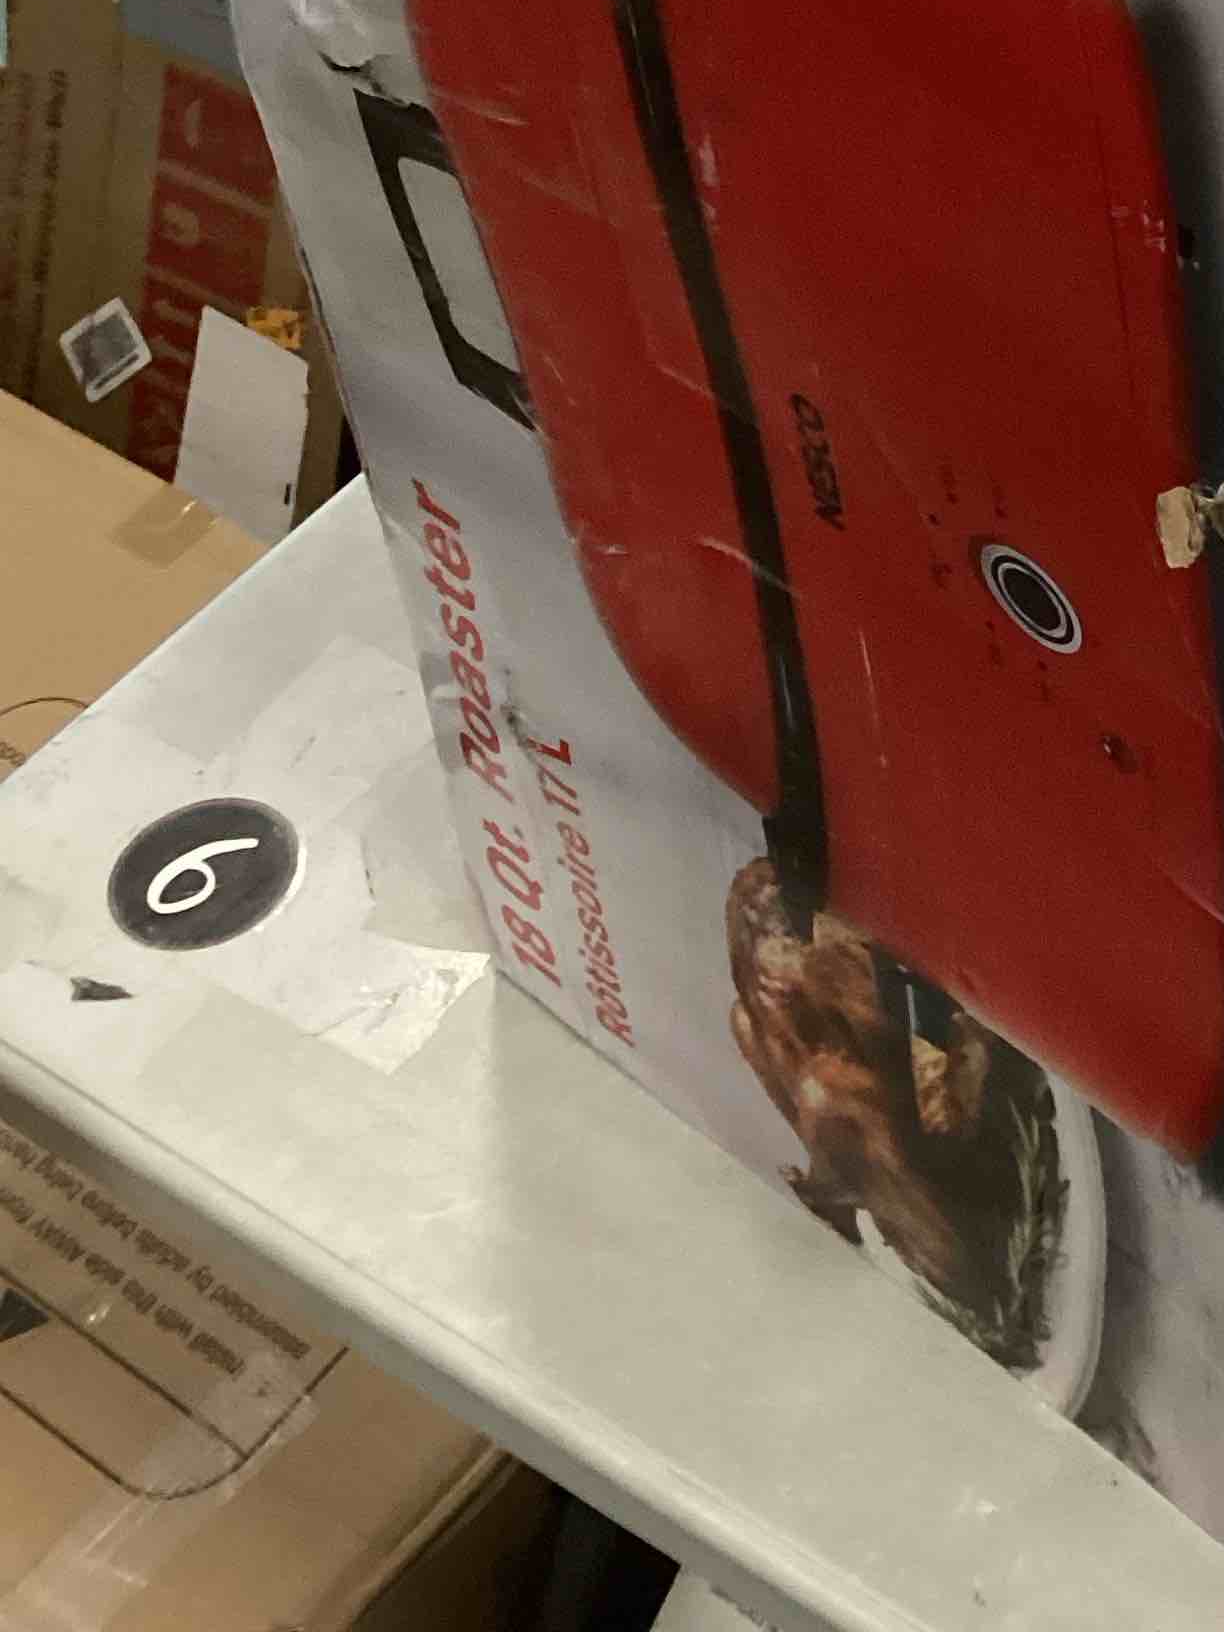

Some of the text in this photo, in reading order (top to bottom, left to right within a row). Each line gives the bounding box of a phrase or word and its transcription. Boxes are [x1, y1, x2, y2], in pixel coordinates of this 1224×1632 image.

[411, 477, 563, 989] 18 Qt. Roaster
